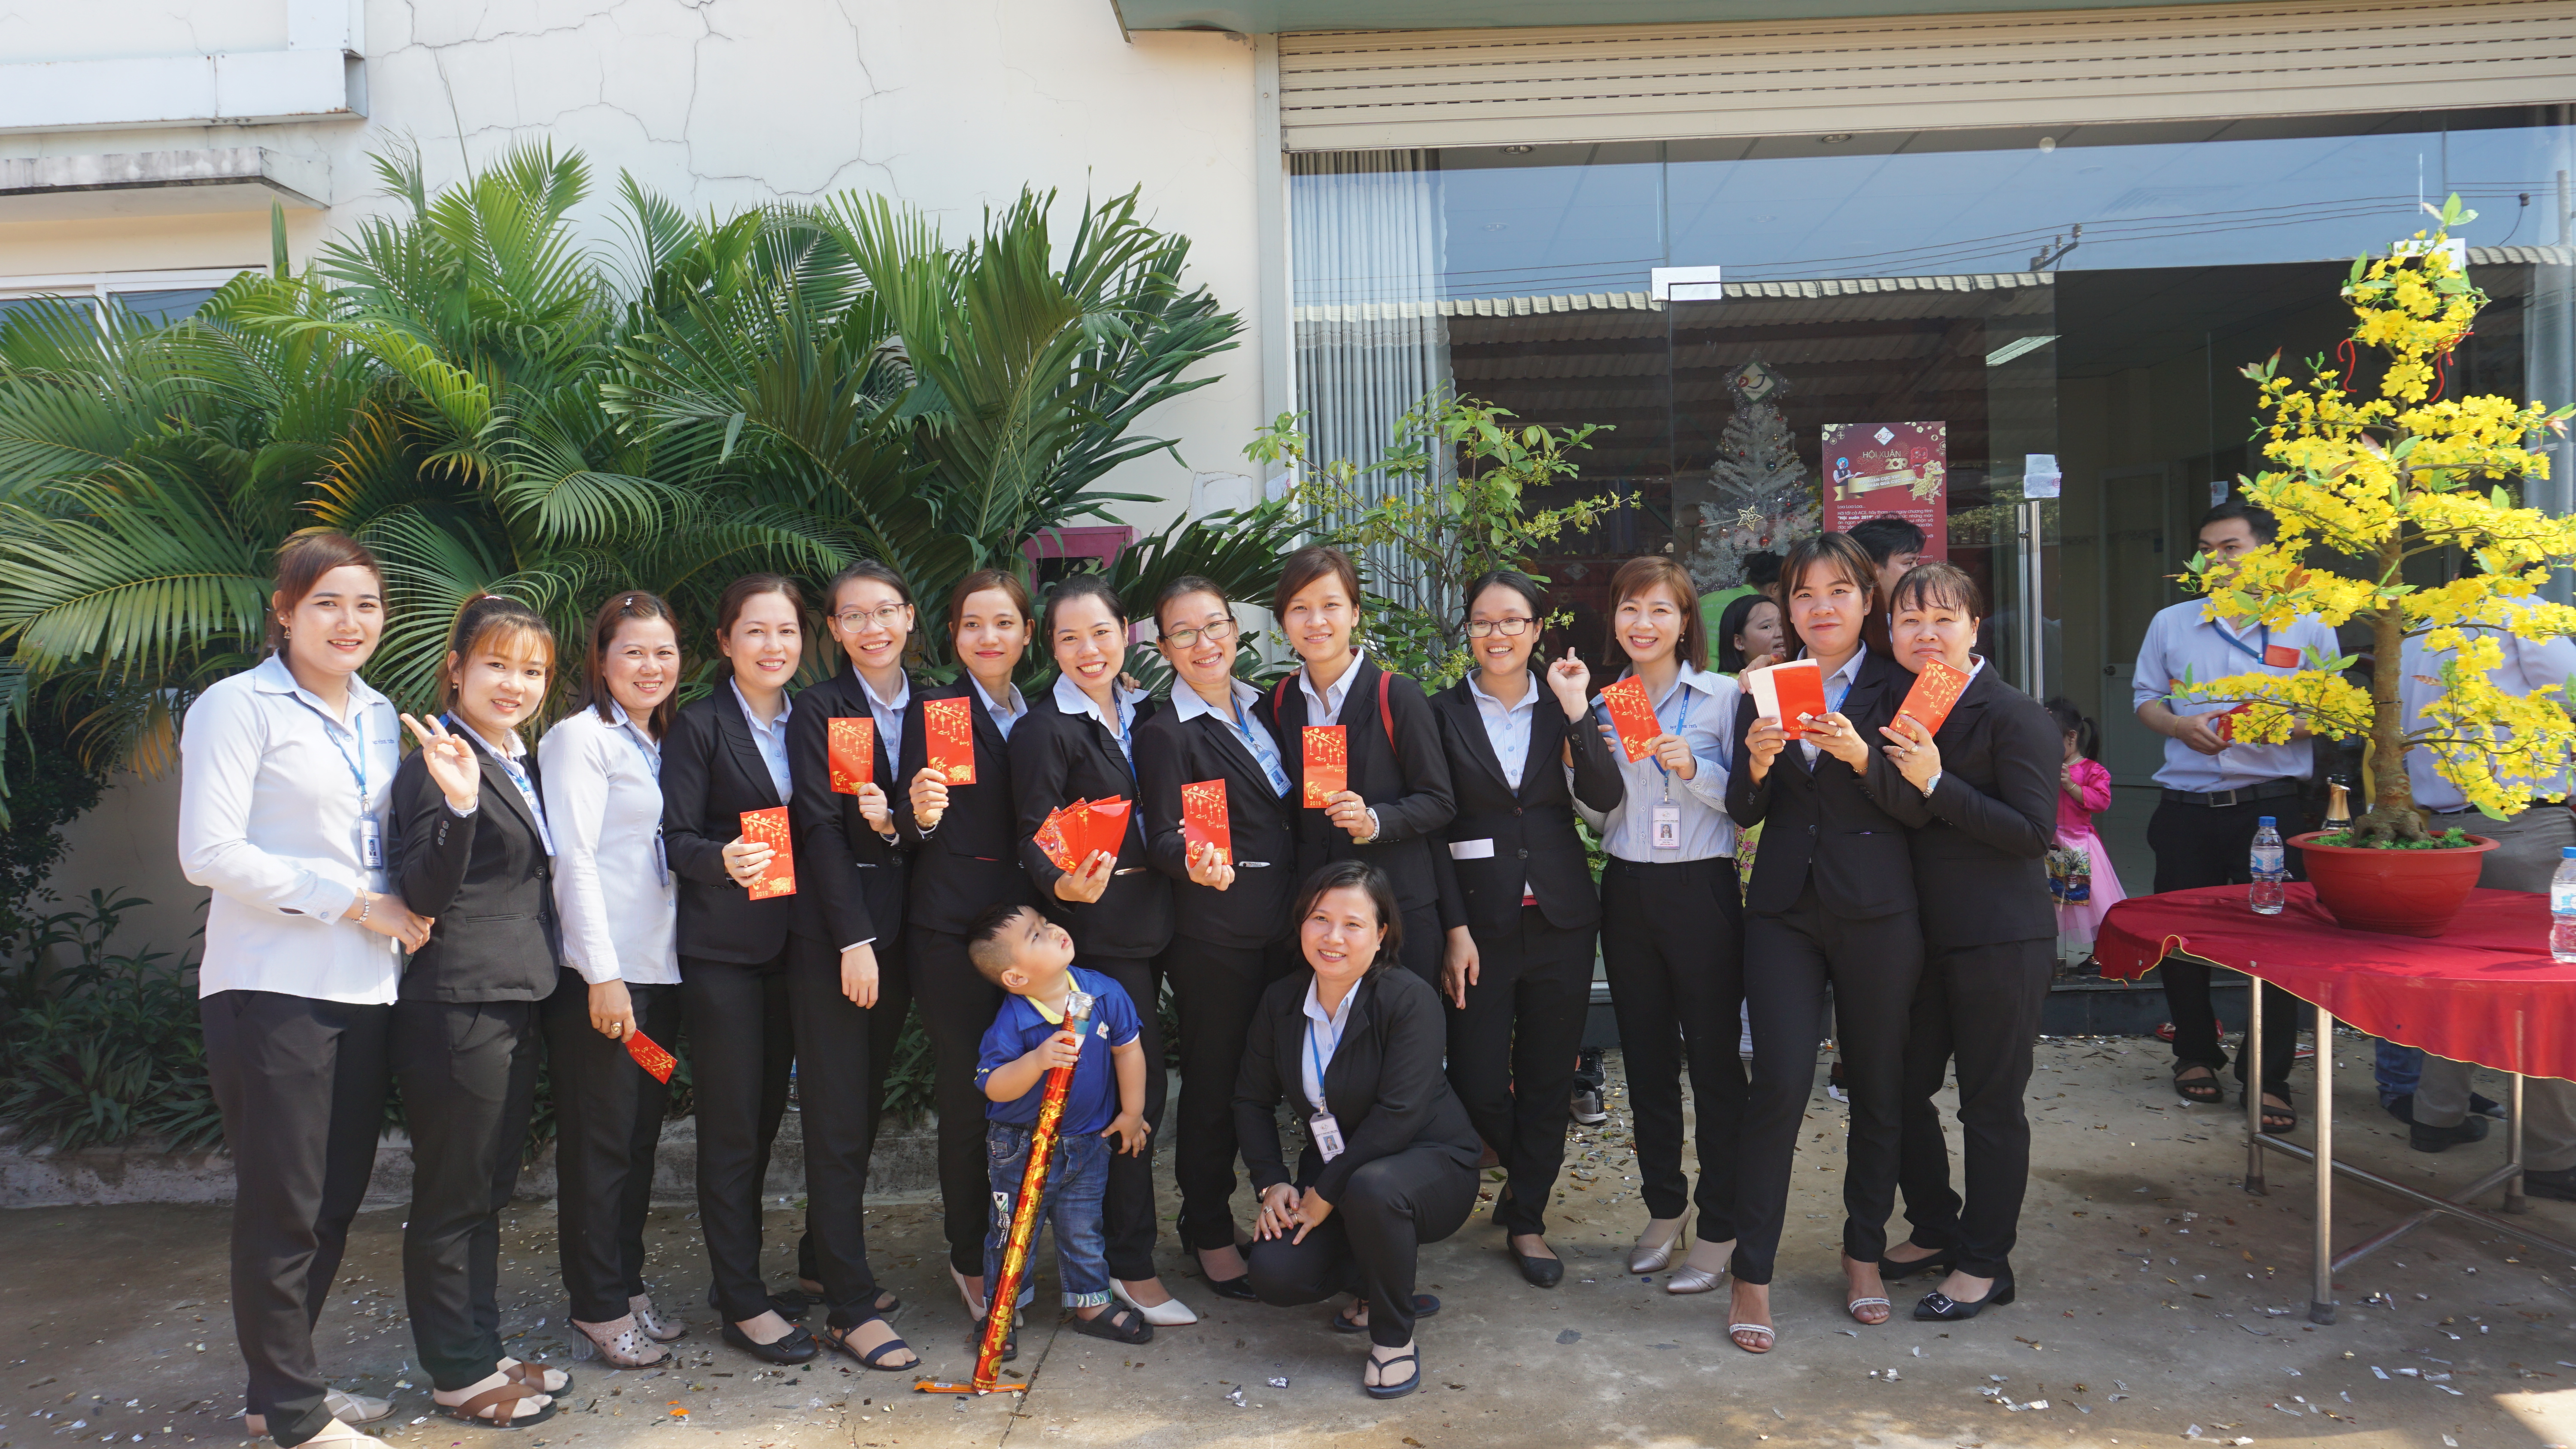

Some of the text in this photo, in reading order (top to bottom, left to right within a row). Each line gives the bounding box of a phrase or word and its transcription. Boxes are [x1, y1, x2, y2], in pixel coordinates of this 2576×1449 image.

[1863, 449, 1902, 459] HỘI XUÂN
[1885, 458, 1908, 470] 2019
